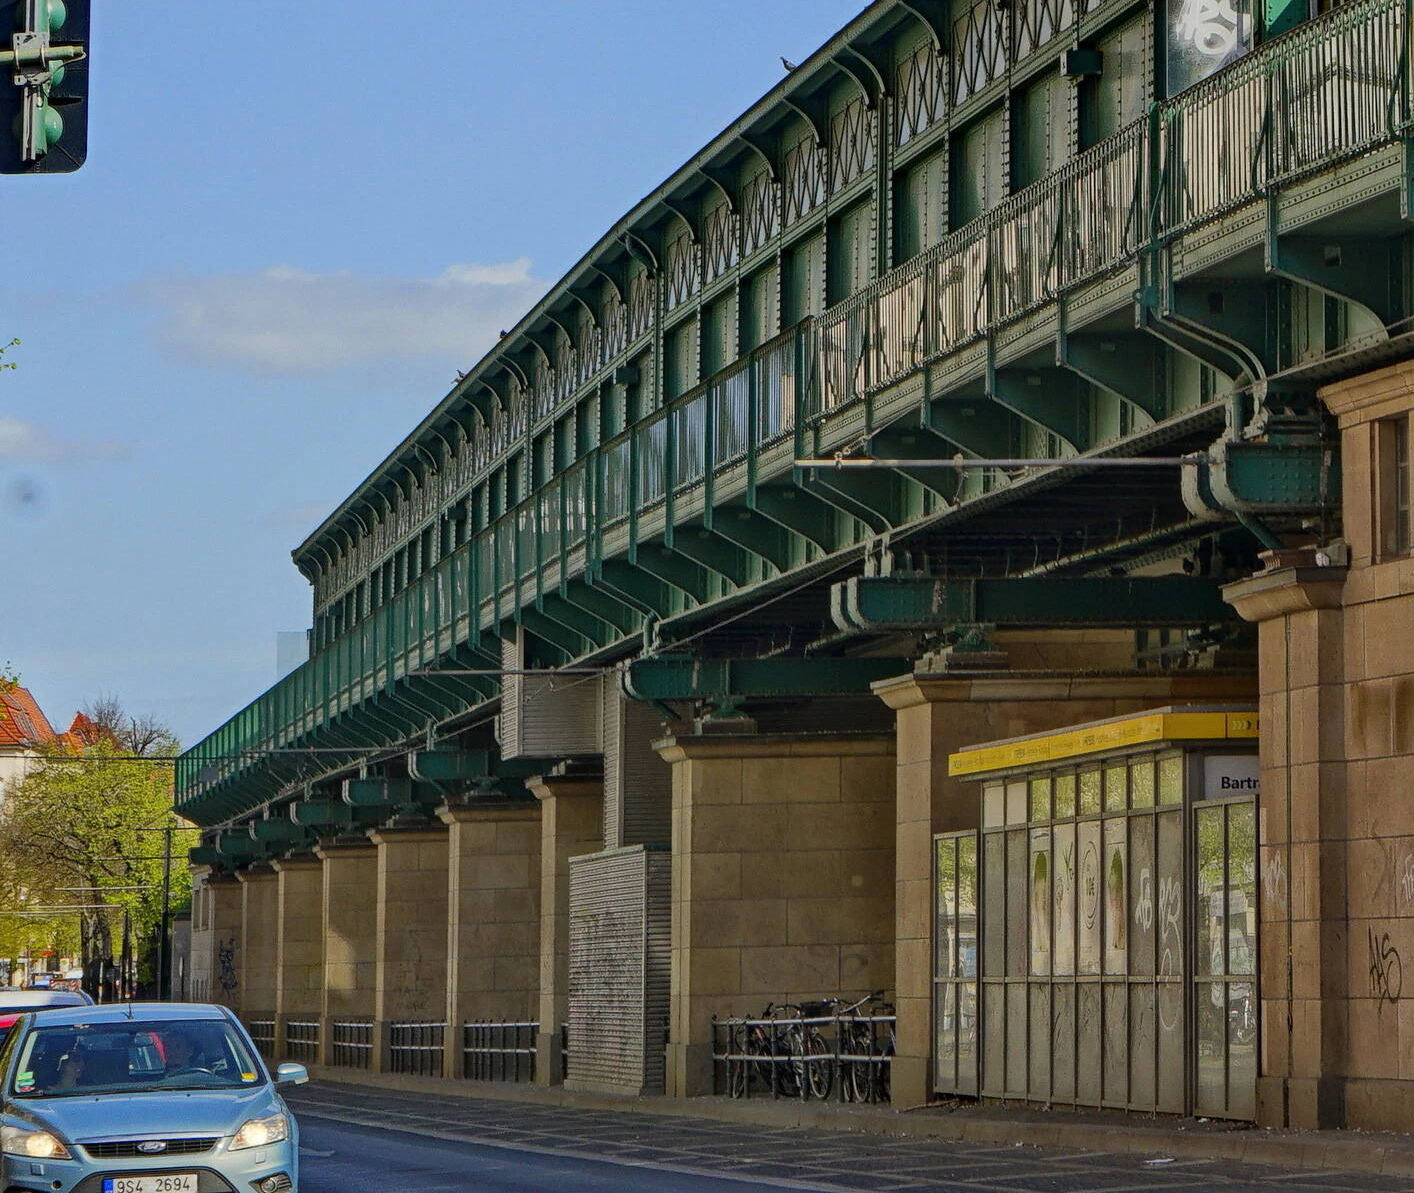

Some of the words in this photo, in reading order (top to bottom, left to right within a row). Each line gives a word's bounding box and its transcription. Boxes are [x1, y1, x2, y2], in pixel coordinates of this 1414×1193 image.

[1221, 776, 1260, 790] Bartr
[116, 1178, 143, 1193] 9S4
[155, 1176, 190, 1192] 2694
